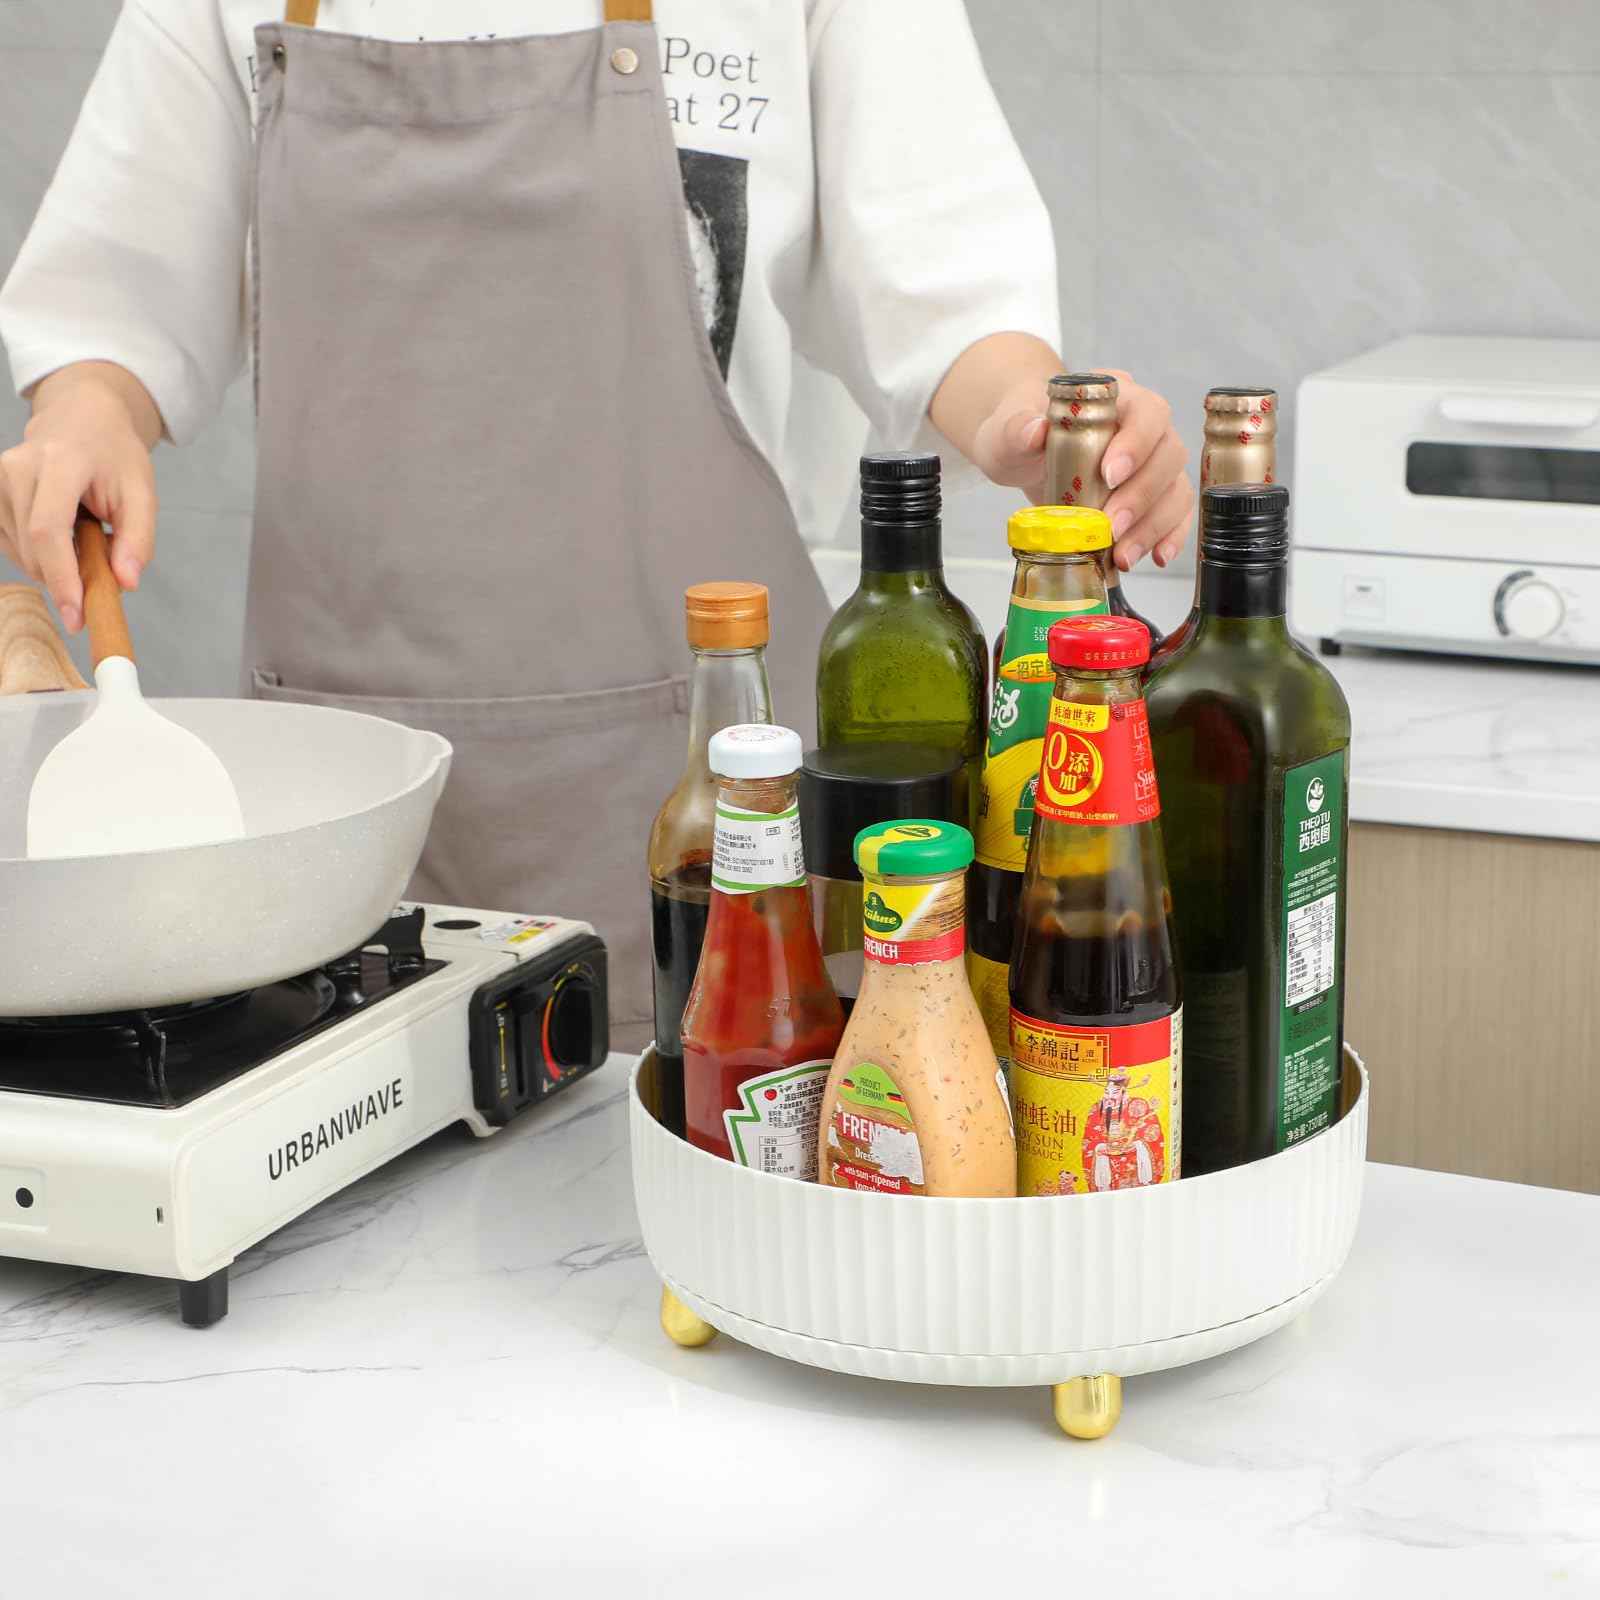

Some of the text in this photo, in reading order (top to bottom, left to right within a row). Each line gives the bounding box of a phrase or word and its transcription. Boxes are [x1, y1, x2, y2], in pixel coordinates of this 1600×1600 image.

[661, 37, 761, 84] Poet
[717, 92, 770, 134] 27
[1299, 810, 1331, 832] THEOTU
[268, 1078, 403, 1181] URBANWAVE
[1034, 1134, 1064, 1149] SUN
[855, 1167, 901, 1189] sun-ripened
